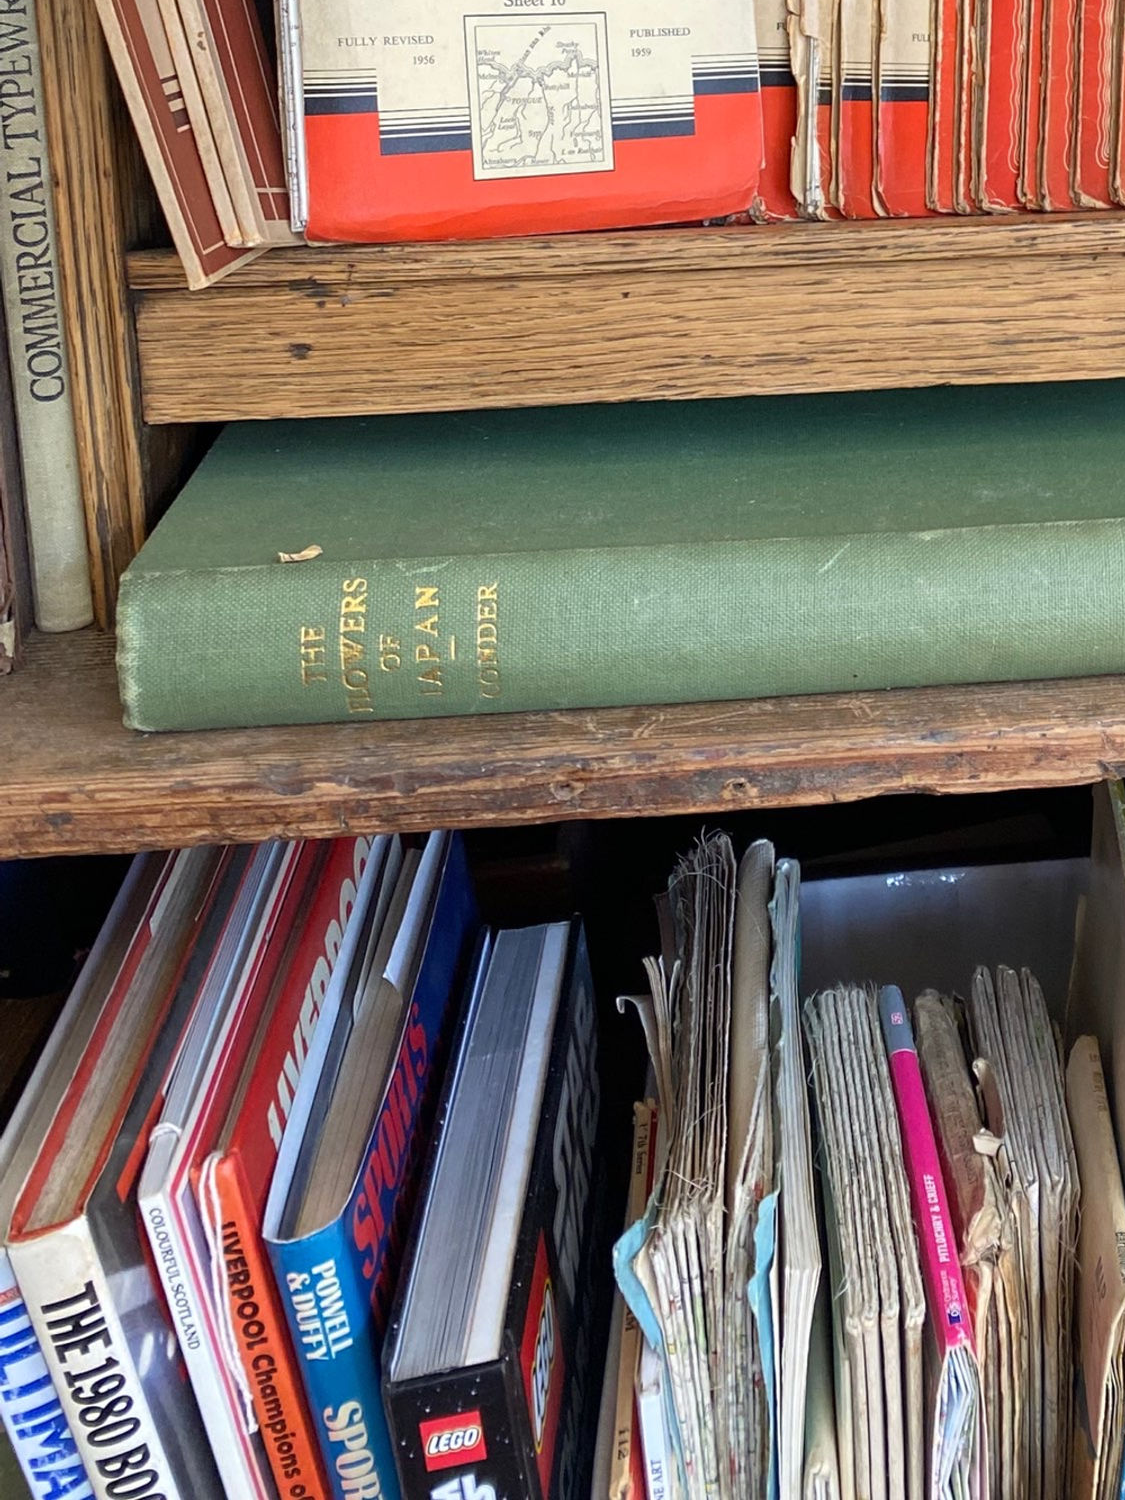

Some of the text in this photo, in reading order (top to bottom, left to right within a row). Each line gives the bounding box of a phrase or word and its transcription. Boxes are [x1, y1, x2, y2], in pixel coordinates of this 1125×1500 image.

[337, 34, 435, 49] FULLY REVISED
[412, 54, 436, 67] 1956
[629, 26, 691, 40] PUBLISHED
[630, 47, 653, 59] 1959
[6, 156, 66, 402] COMMERCIAL
[301, 623, 328, 688] THE
[379, 633, 401, 673] OF
[922, 1173, 950, 1264] PITLOCHRY & CRIEFF
[148, 1206, 202, 1351] COLOURFUL SCOTLAND
[285, 1271, 330, 1361] & DUFFY
[311, 1257, 355, 1360] POWELL
[40, 1279, 113, 1364] THE
[62, 1355, 141, 1448] 1980
[251, 1353, 302, 1481] Champions
[427, 1426, 481, 1456] LEGO
[322, 1400, 383, 1500] SPOR
[651, 1459, 666, 1484] ART
